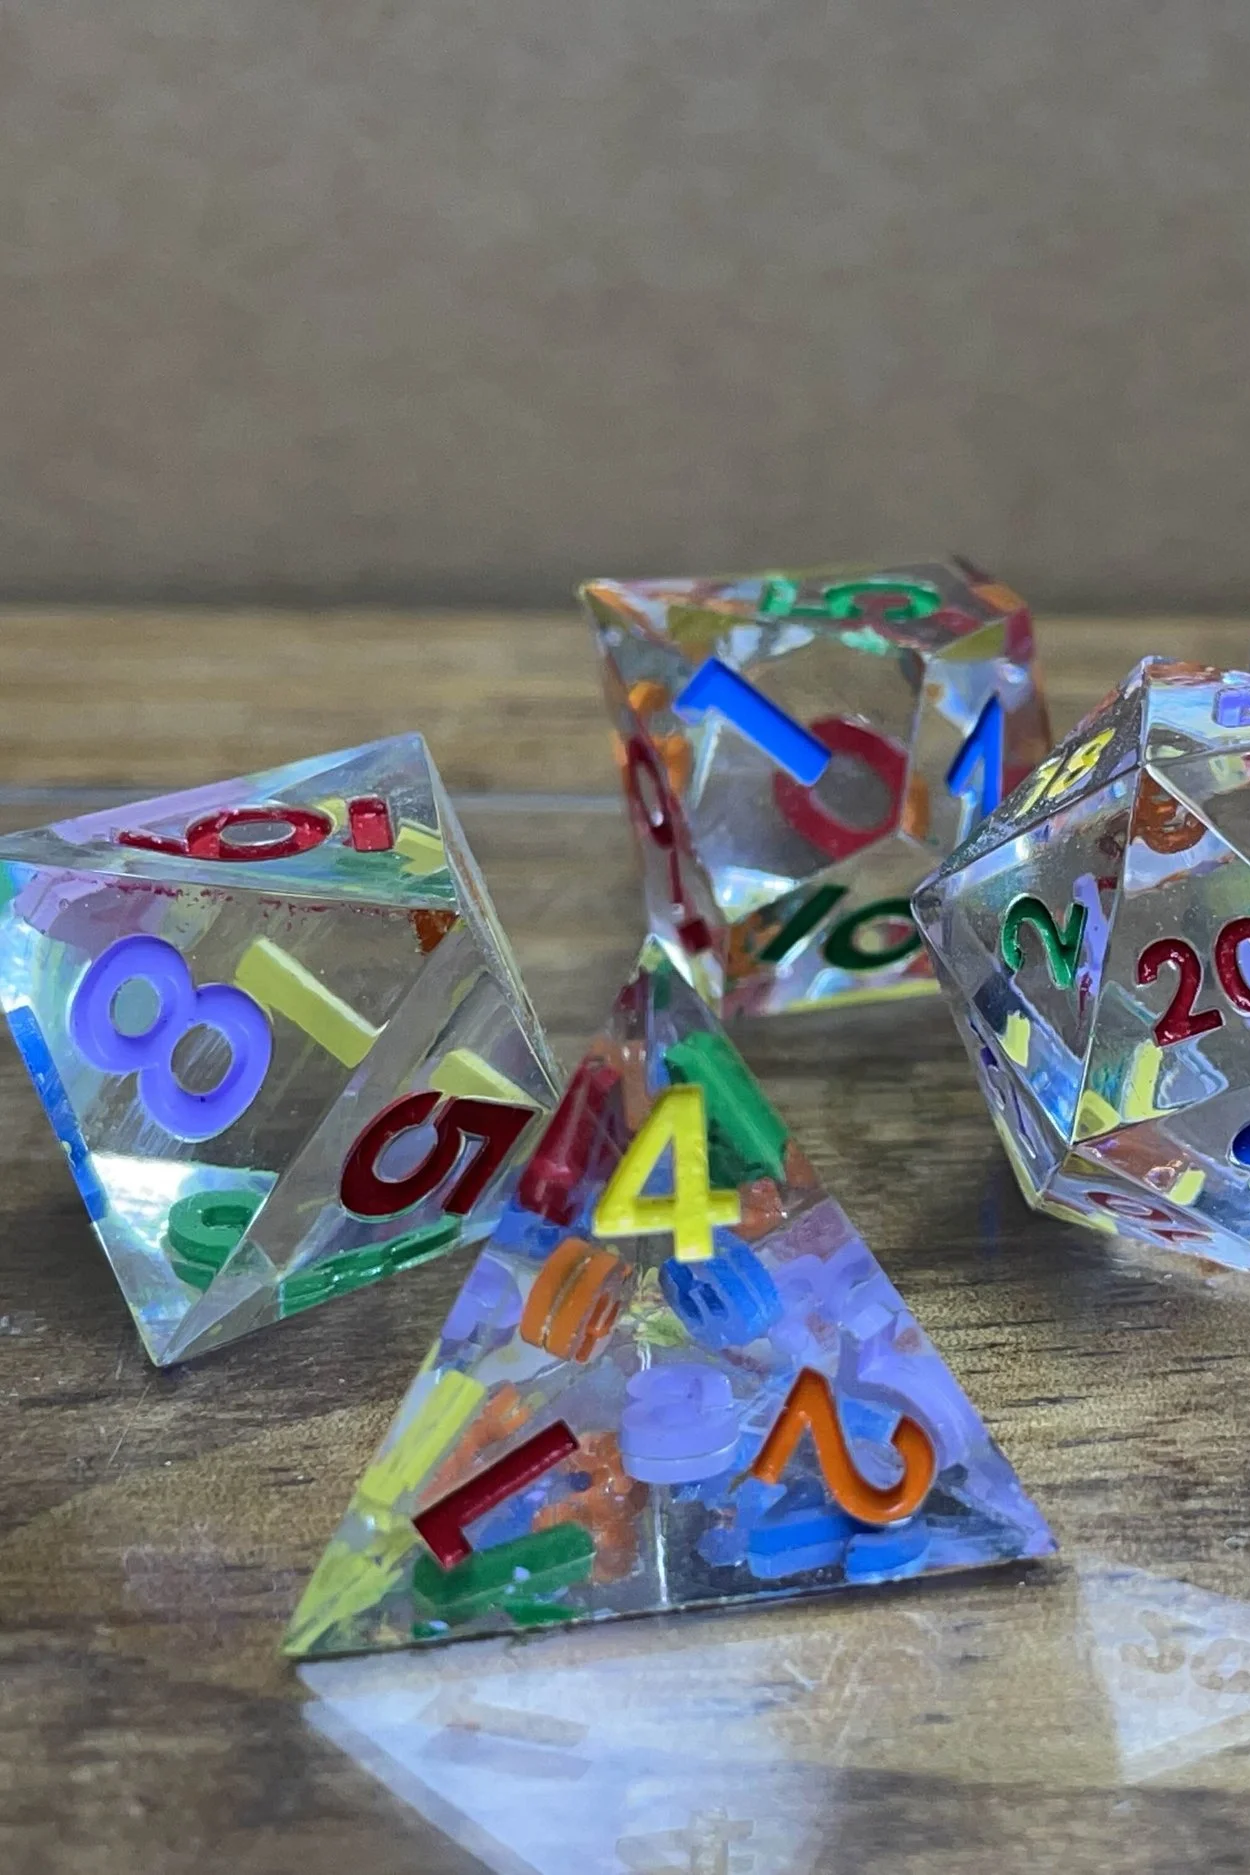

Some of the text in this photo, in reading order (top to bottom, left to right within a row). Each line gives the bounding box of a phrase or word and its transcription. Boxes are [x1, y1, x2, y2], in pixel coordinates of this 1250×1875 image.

[1001, 894, 1086, 989] 2
[69, 933, 273, 1141] 8
[339, 1089, 536, 1217] 5
[594, 1084, 742, 1264] 4
[410, 1418, 580, 1570] 1
[751, 1365, 935, 1525] 2
